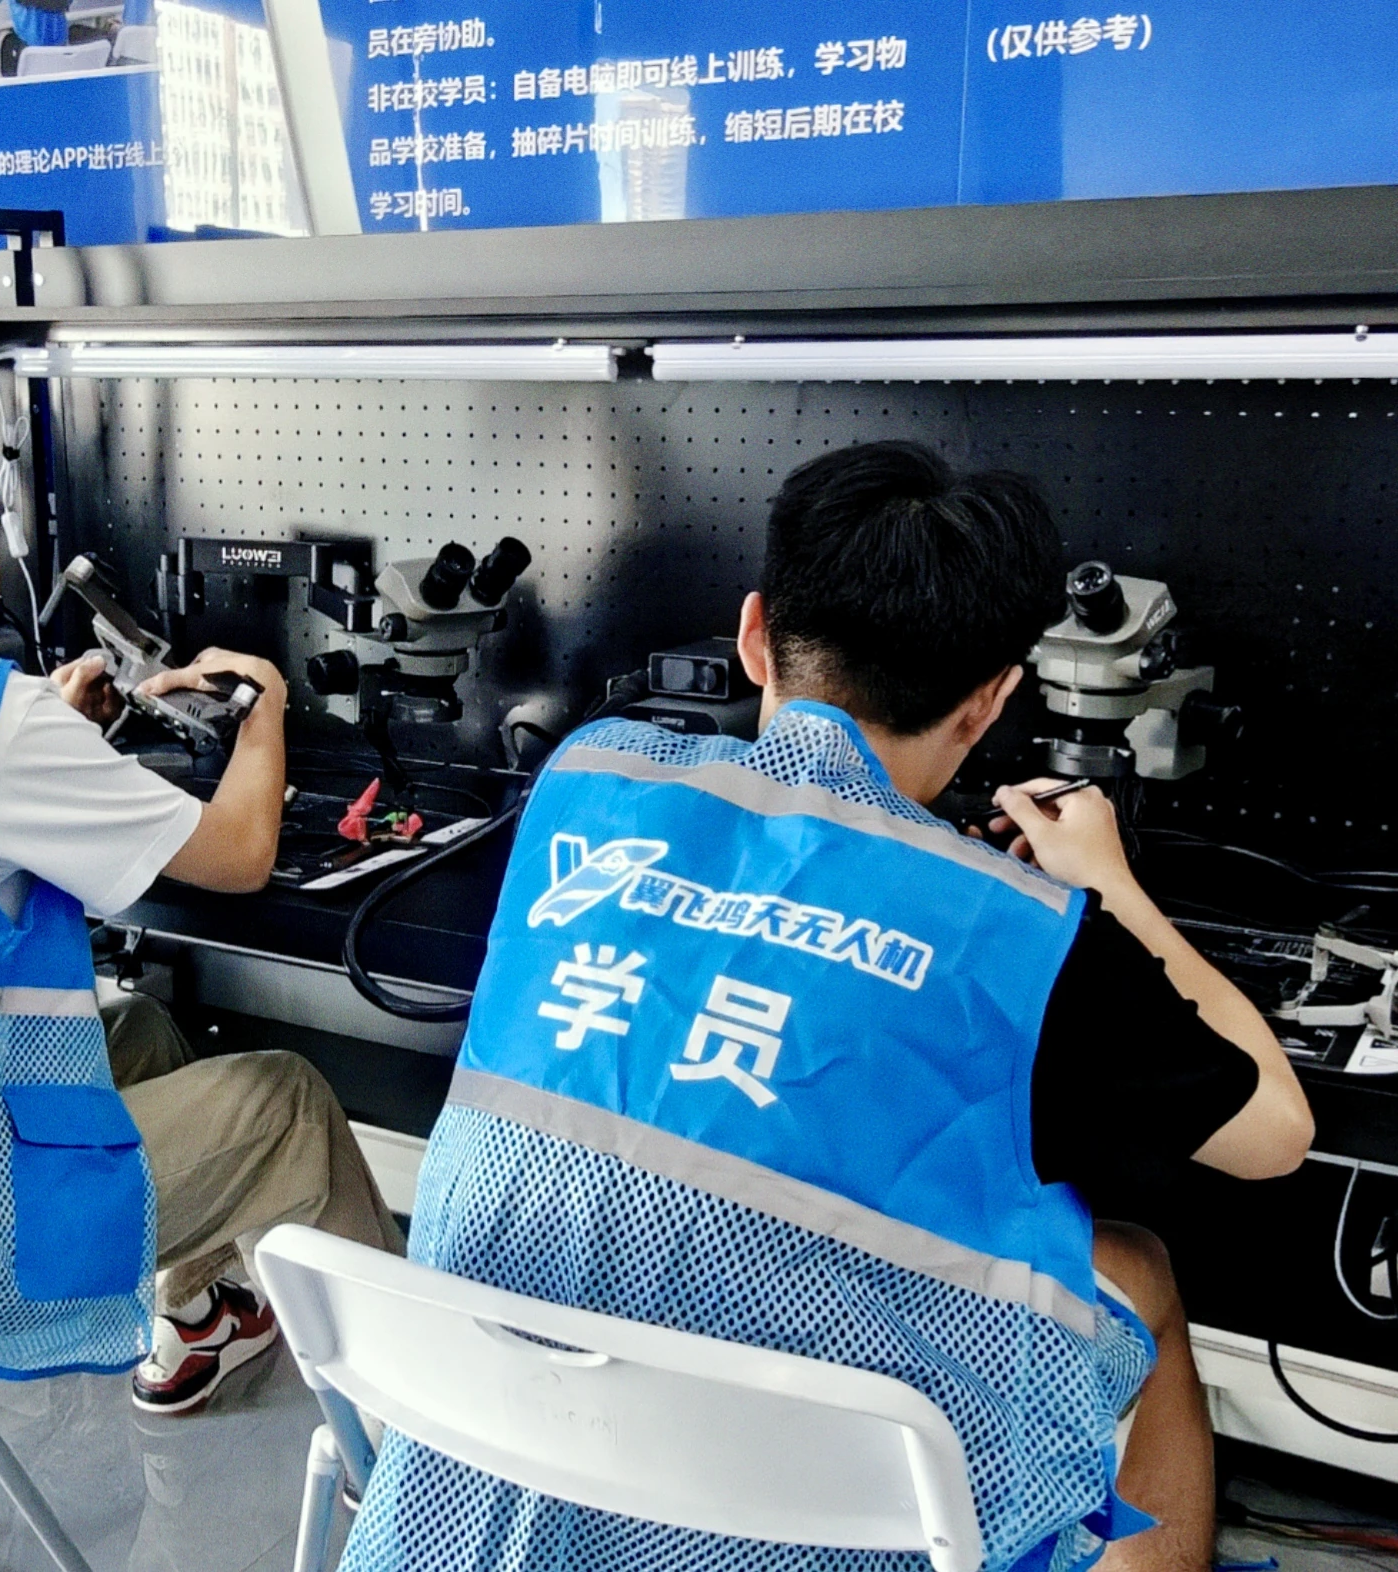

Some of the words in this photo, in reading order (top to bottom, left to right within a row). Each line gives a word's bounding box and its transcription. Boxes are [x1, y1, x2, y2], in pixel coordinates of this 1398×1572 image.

[368, 17, 495, 58] 员在旁协助。
[986, 14, 1153, 62] (仅供参考)
[370, 188, 471, 220] 学习时间。
[621, 870, 932, 990] 翼飞鸿天无人机
[538, 943, 791, 1108] 学员
